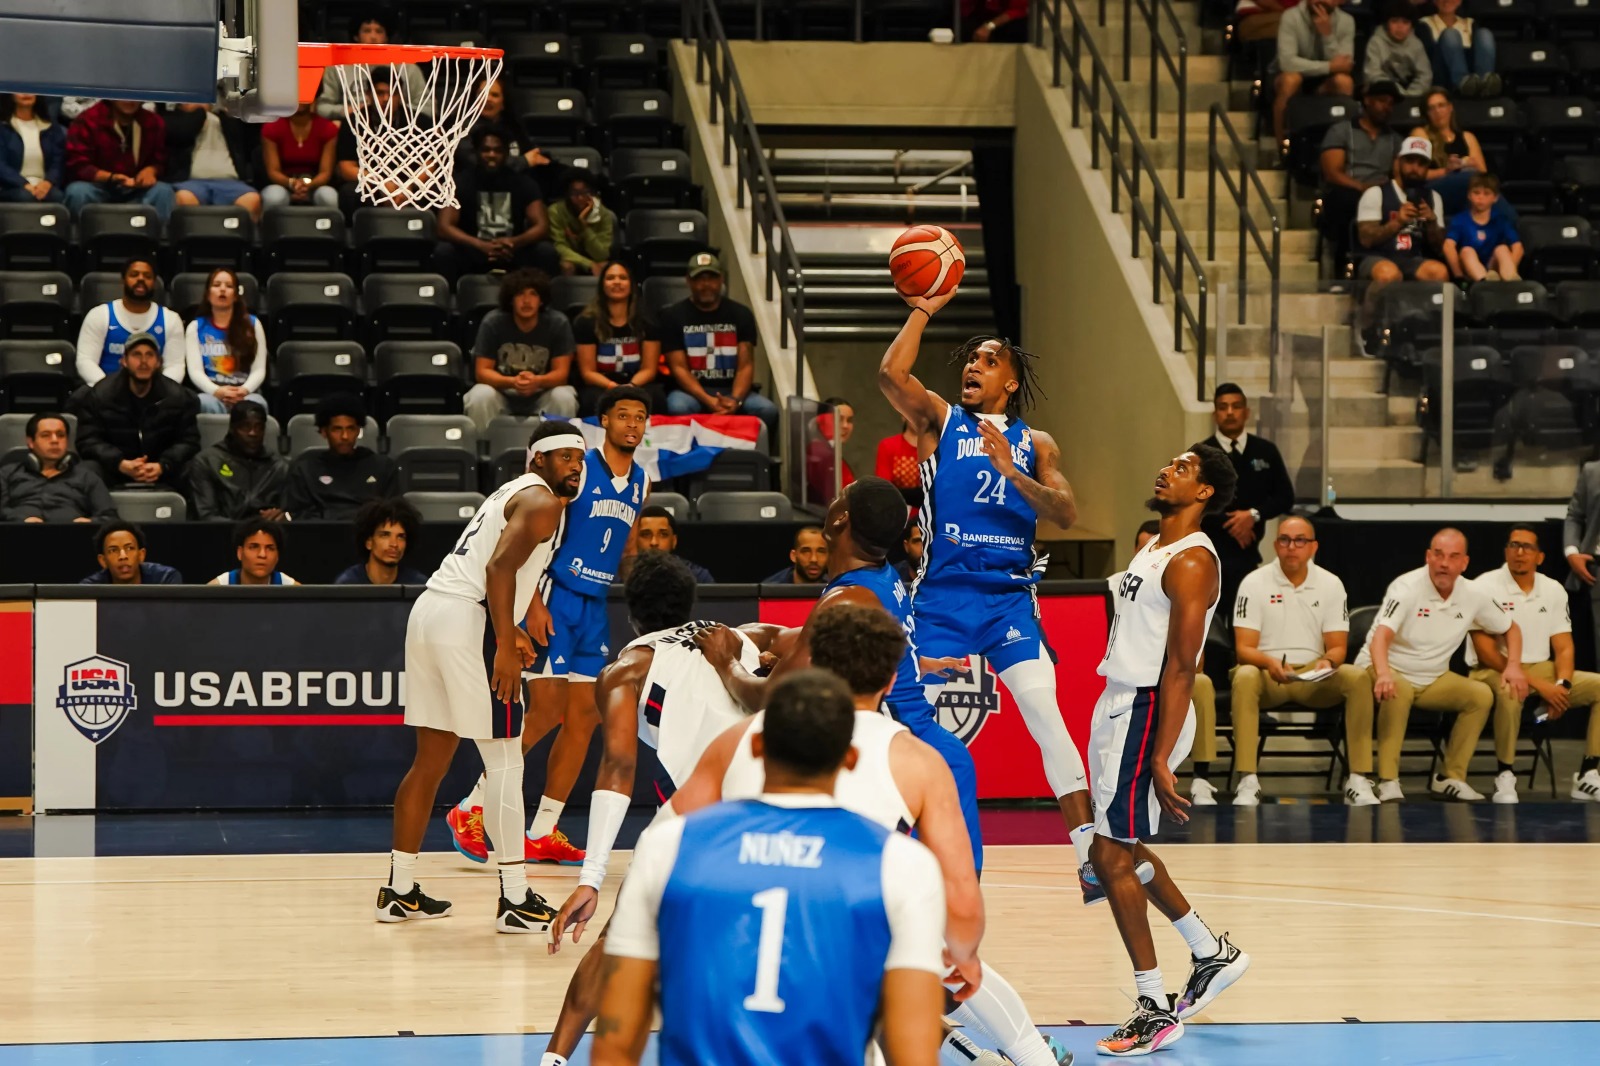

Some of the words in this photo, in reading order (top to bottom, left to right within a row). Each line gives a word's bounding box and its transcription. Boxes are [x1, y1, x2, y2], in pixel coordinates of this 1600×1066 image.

[973, 470, 1006, 505] 24
[600, 527, 612, 553] 9
[962, 533, 1025, 545] BANRESERVAS
[72, 669, 120, 691] USA
[154, 671, 405, 707] USABFOU
[59, 697, 131, 705] BASKETBALL
[940, 694, 991, 705] TBALL
[738, 830, 825, 868] NUÑEZ
[743, 886, 789, 1013] 1
